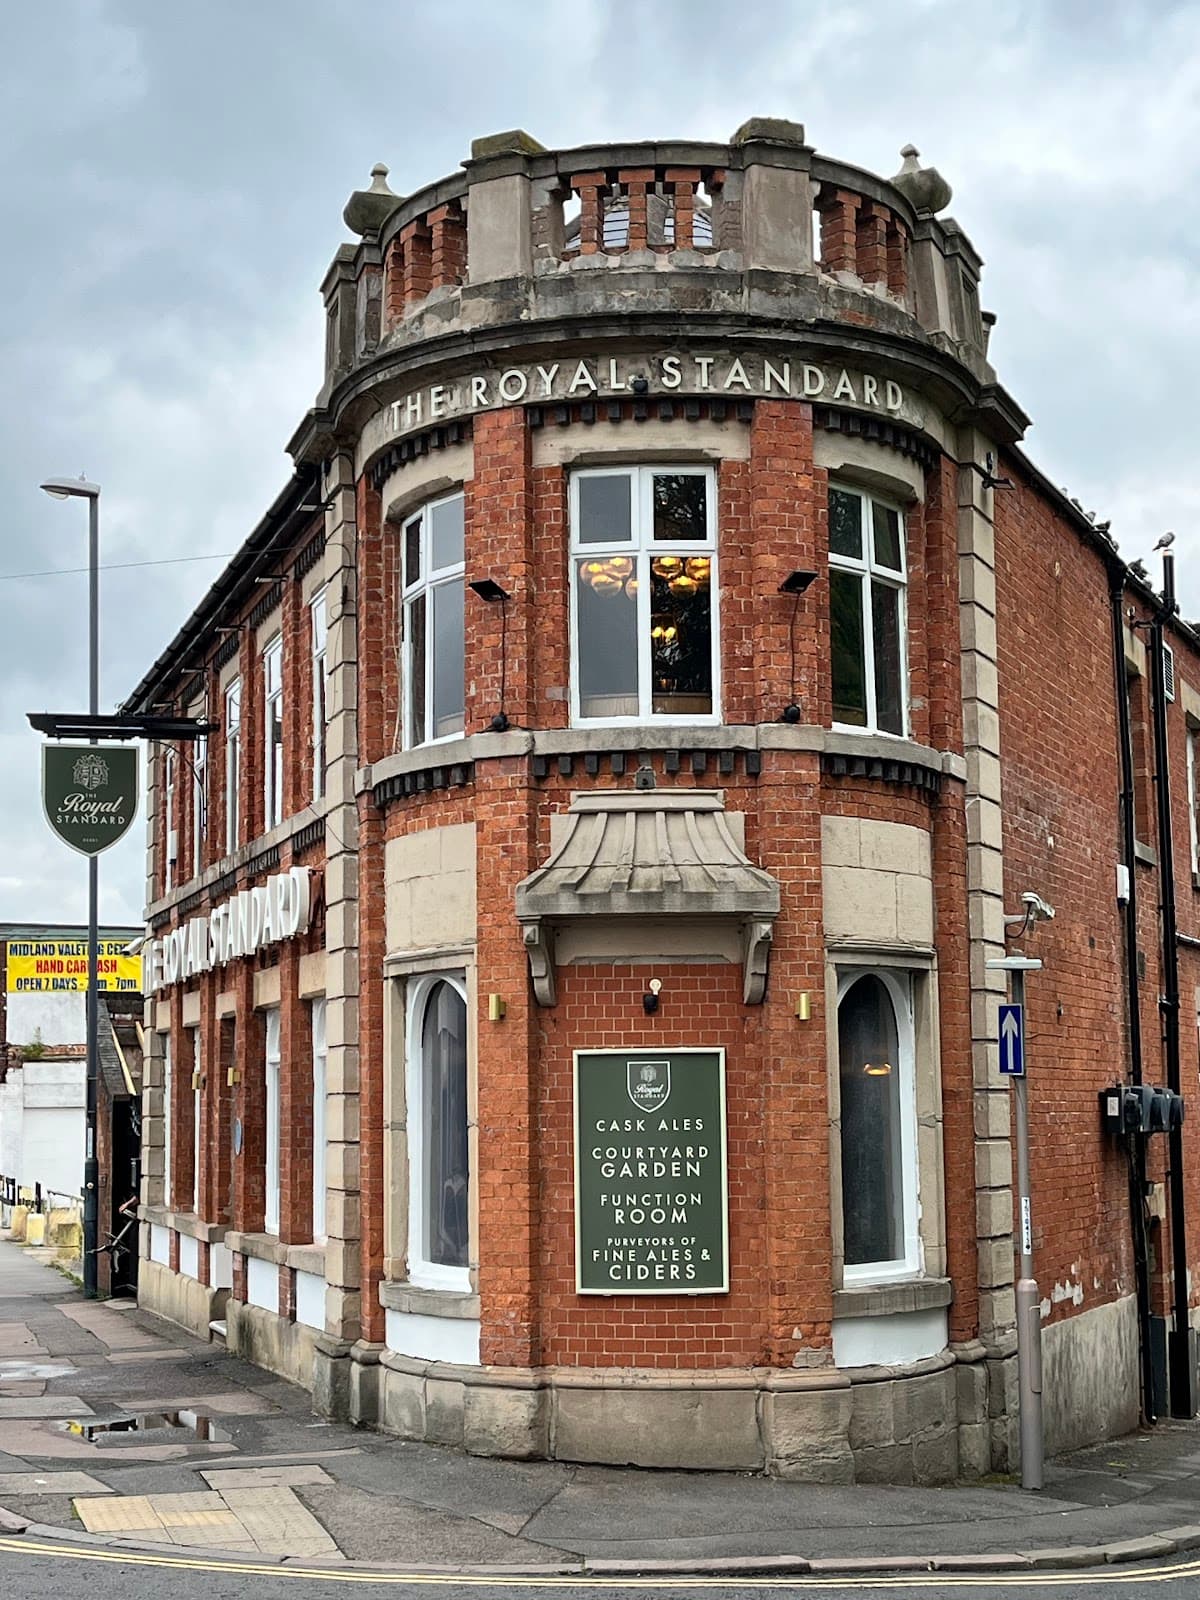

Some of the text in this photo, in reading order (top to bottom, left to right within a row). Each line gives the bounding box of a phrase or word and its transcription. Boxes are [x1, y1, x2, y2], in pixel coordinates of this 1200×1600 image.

[391, 356, 904, 431] THE ROYAL STANDARD
[58, 793, 124, 817] Royal
[57, 815, 125, 824] STANDARD
[209, 866, 312, 967] STANDARD
[10, 944, 55, 956] MIDLAND
[36, 959, 117, 973] HAND CAR ASH
[16, 977, 42, 990] OPEN
[44, 978, 49, 990] 7
[52, 977, 78, 990] DAYS
[115, 977, 137, 990] 7pm
[596, 1118, 704, 1132] CASK ALES
[592, 1146, 709, 1160] COURTYARD
[601, 1161, 700, 1178] GARDEN
[601, 1193, 702, 1206] FUNCTION
[615, 1208, 687, 1225] ROOM
[607, 1237, 696, 1246] PURVEYORS OF
[592, 1248, 711, 1261] FINE ALES &
[609, 1264, 696, 1280] CIDERS
